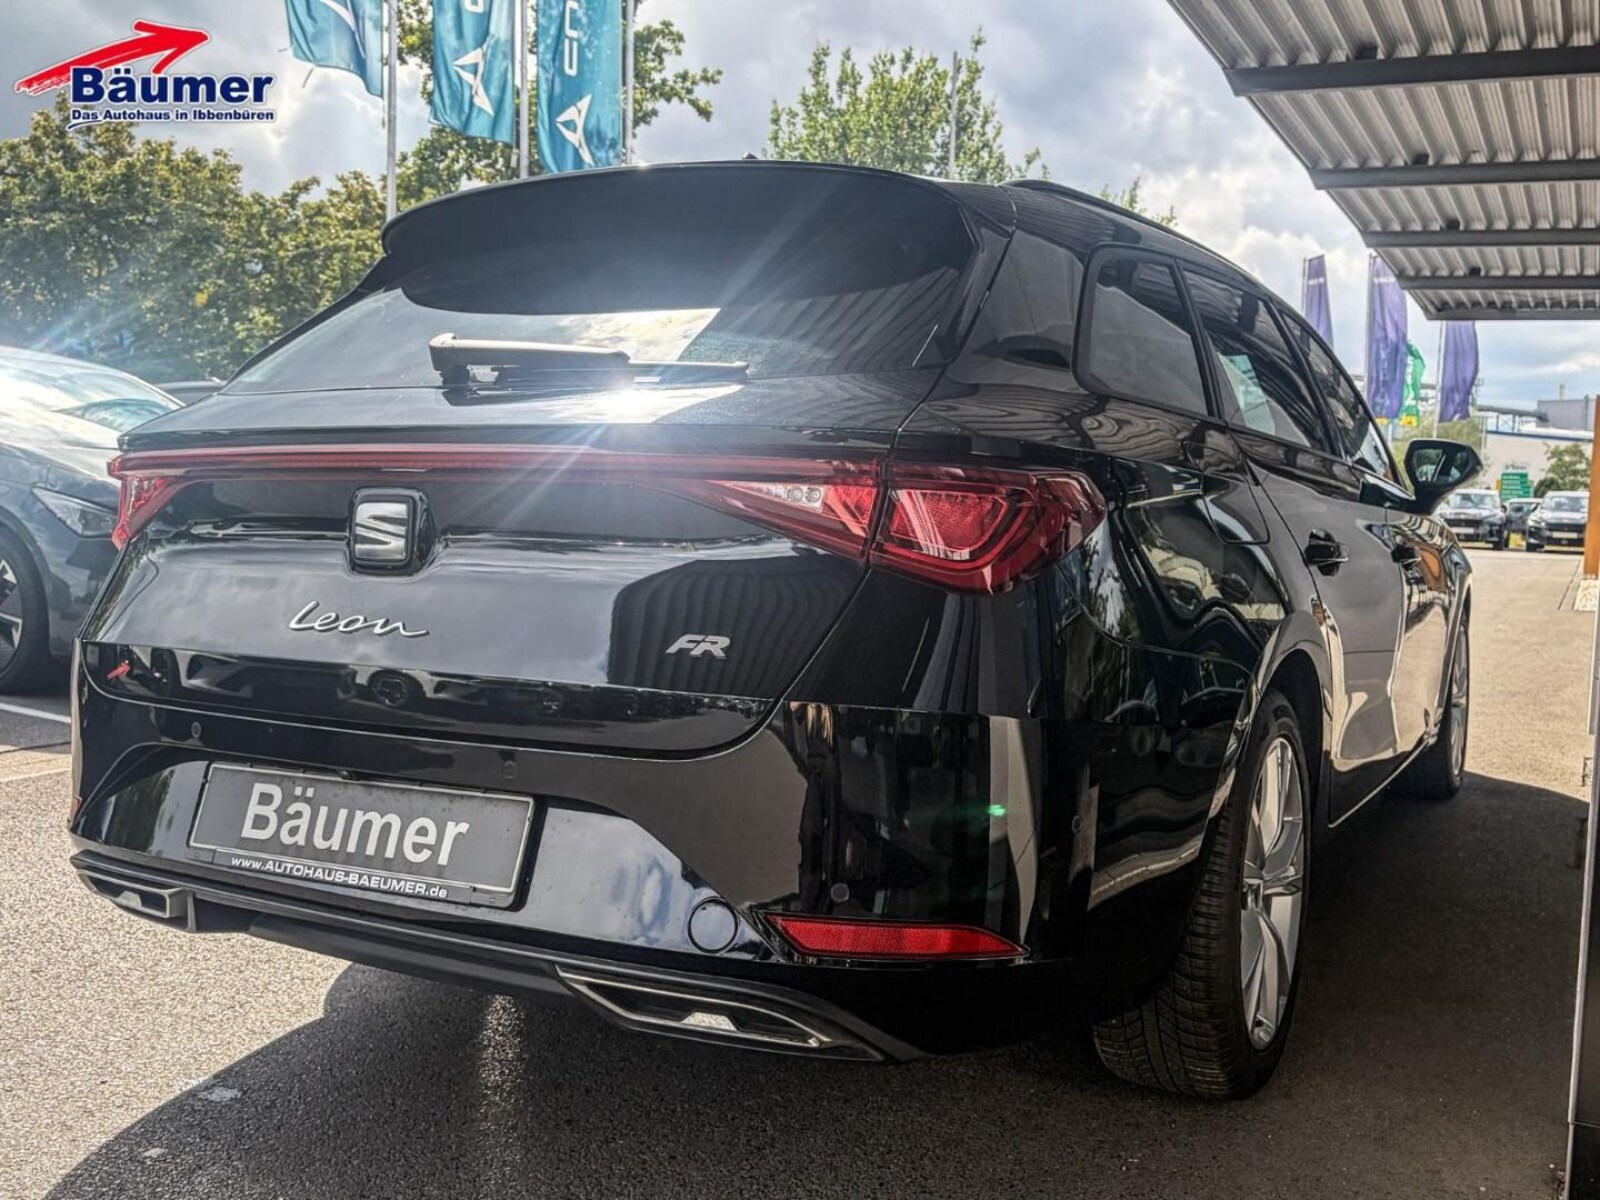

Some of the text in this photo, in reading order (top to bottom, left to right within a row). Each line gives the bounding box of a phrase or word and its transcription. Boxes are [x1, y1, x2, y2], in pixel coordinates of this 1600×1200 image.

[289, 600, 430, 639] Leon
[665, 633, 731, 660] FR
[240, 781, 471, 867] Bäumer
[230, 855, 449, 899] www.AUTOHAUS-BAEUMER.de
